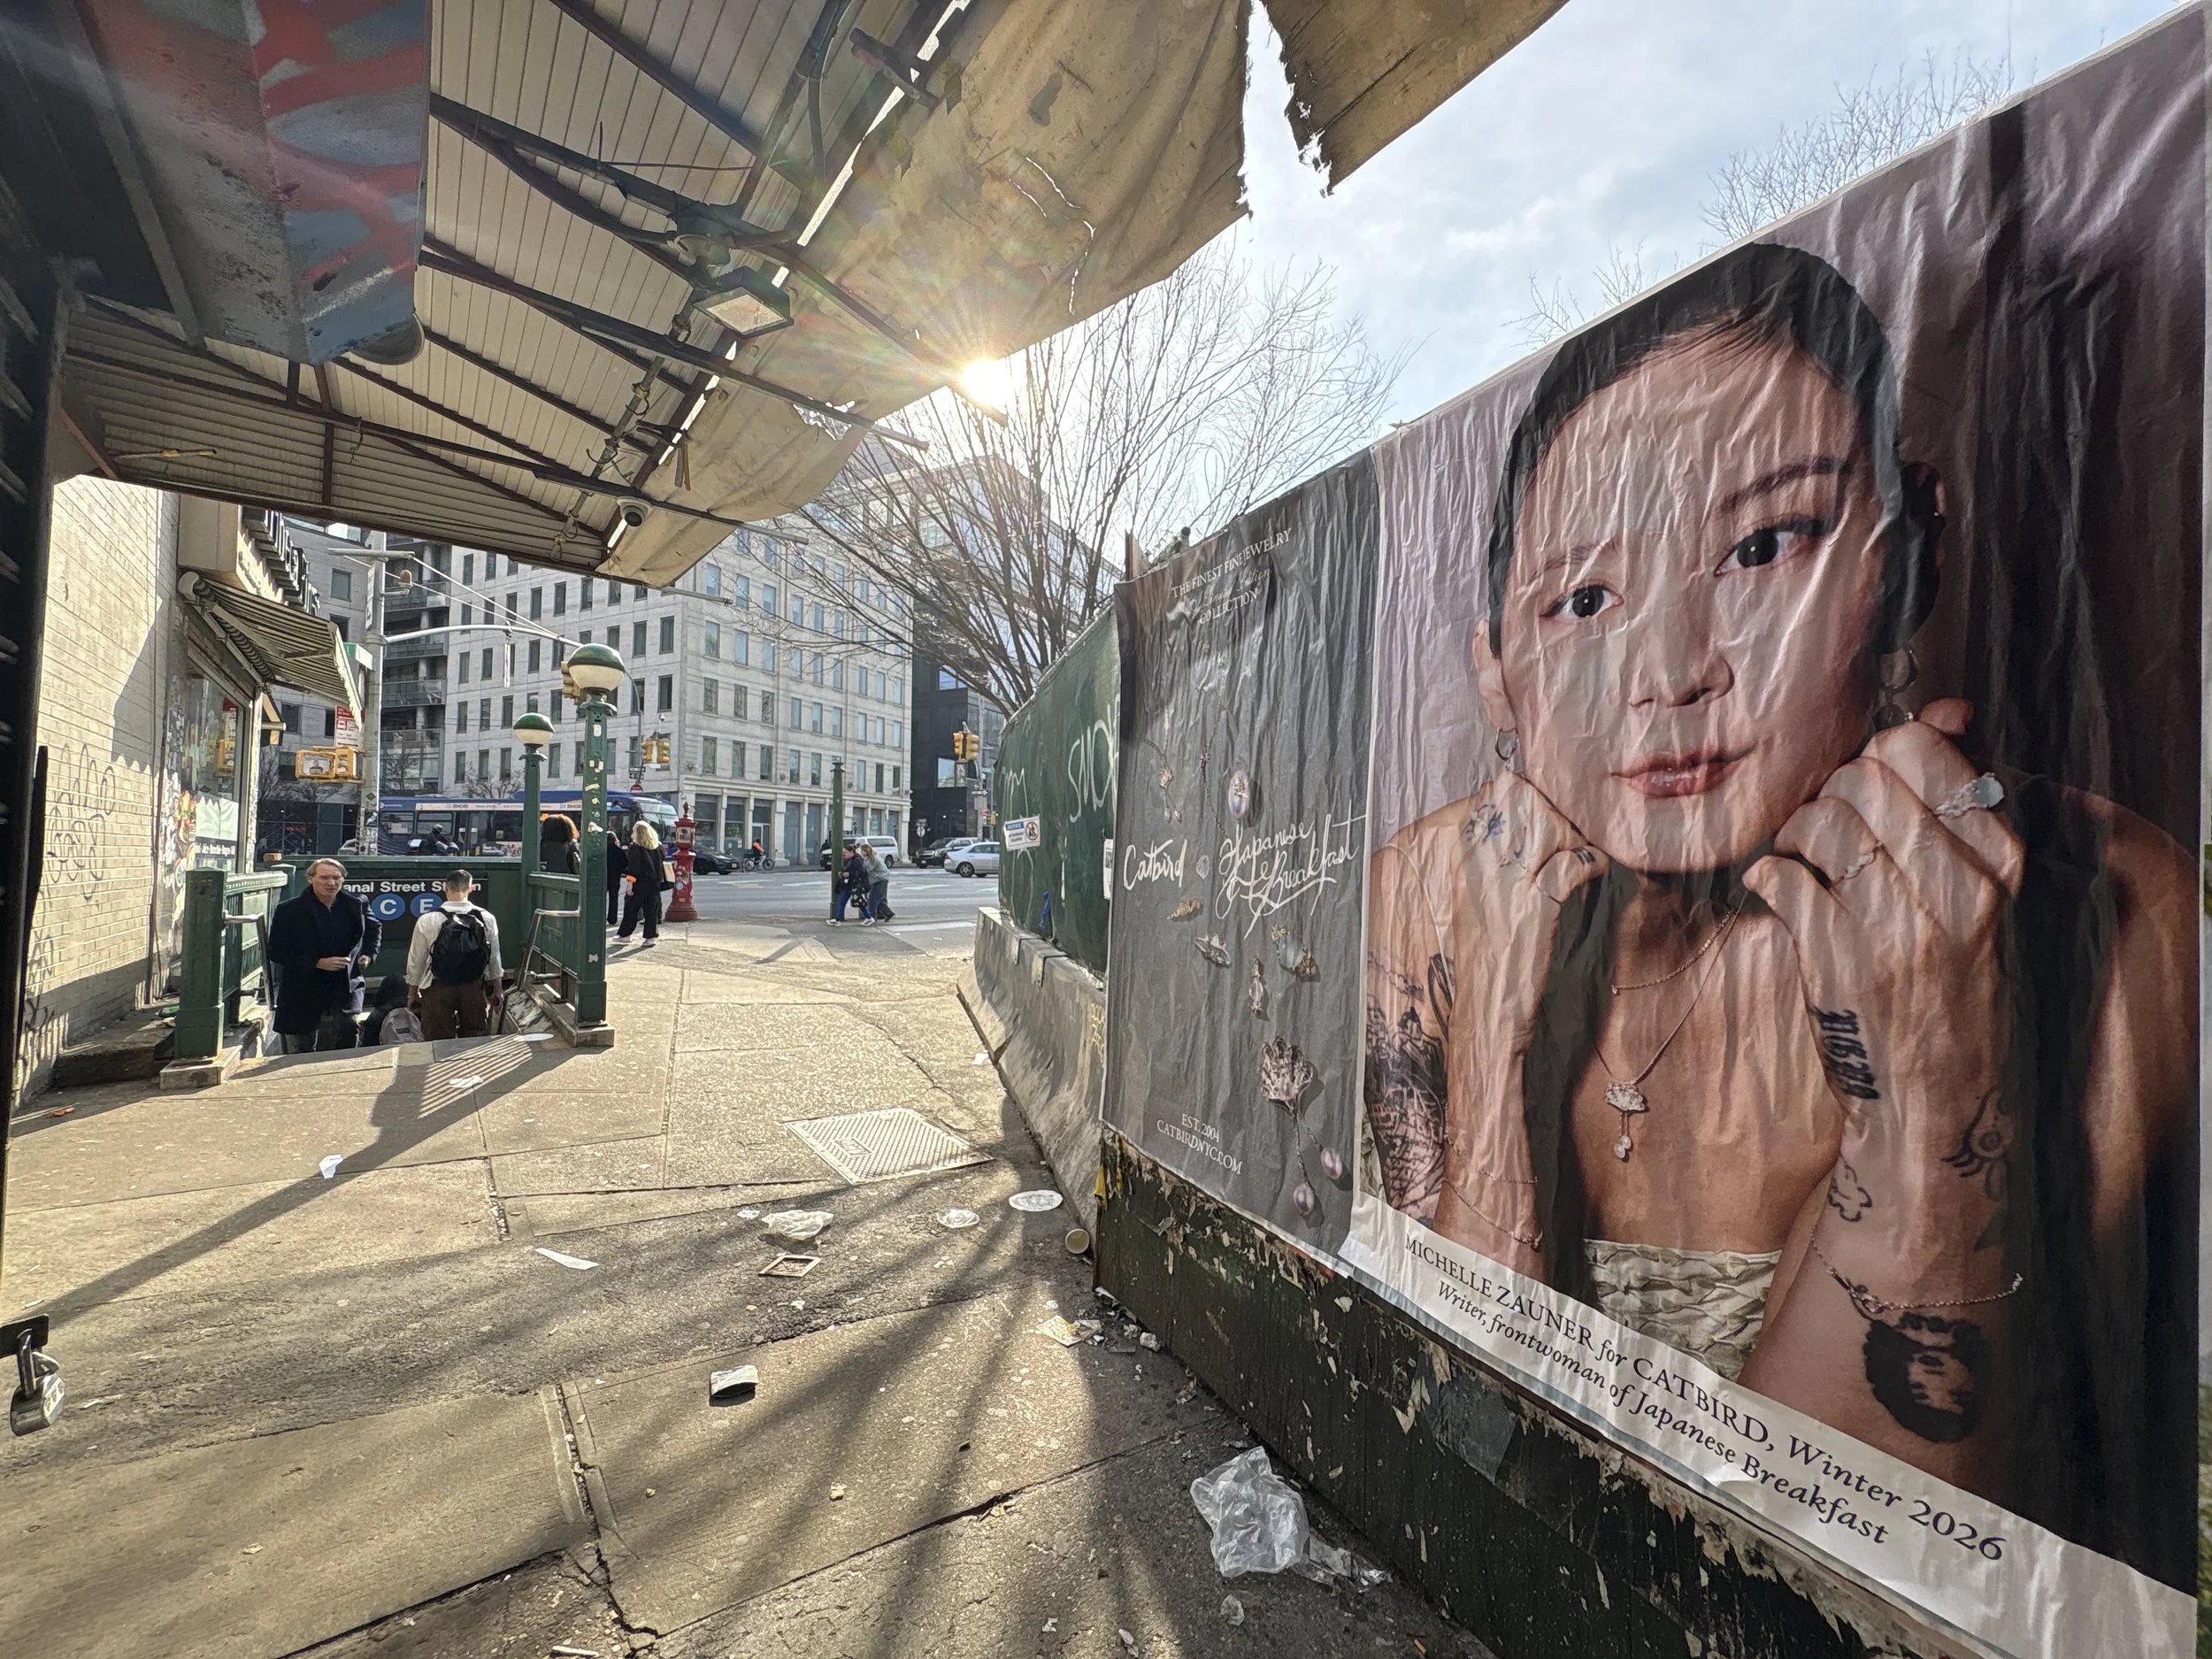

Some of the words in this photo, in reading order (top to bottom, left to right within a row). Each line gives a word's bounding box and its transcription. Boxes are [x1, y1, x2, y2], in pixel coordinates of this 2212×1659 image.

[1171, 580, 1191, 598] THE
[1192, 565, 1223, 589] FINEST
[1224, 552, 1243, 574] FINE
[1242, 527, 1292, 566] JEWELRY
[1199, 588, 1259, 625] COLLECTION
[343, 881, 373, 893] anal
[380, 881, 426, 893] Street
[1123, 839, 1187, 890] Catbird
[380, 899, 397, 915] C
[419, 898, 434, 914] E
[1156, 1119, 1243, 1175] CATBIRDNYC.COM
[1405, 1234, 1493, 1298] MICHELLE
[1495, 1285, 1594, 1351] ZAUNER
[1595, 1339, 1628, 1367] for
[1633, 1357, 1775, 1452] CATBIRD,
[1789, 1434, 1902, 1508] Winter
[1908, 1499, 2007, 1561] 2026
[1438, 1280, 1486, 1326] Writer,
[1486, 1314, 1605, 1389] frontwoman
[1609, 1383, 1636, 1408] of
[1629, 1391, 1736, 1463] Japanese
[1740, 1452, 1889, 1544] Breakfast
